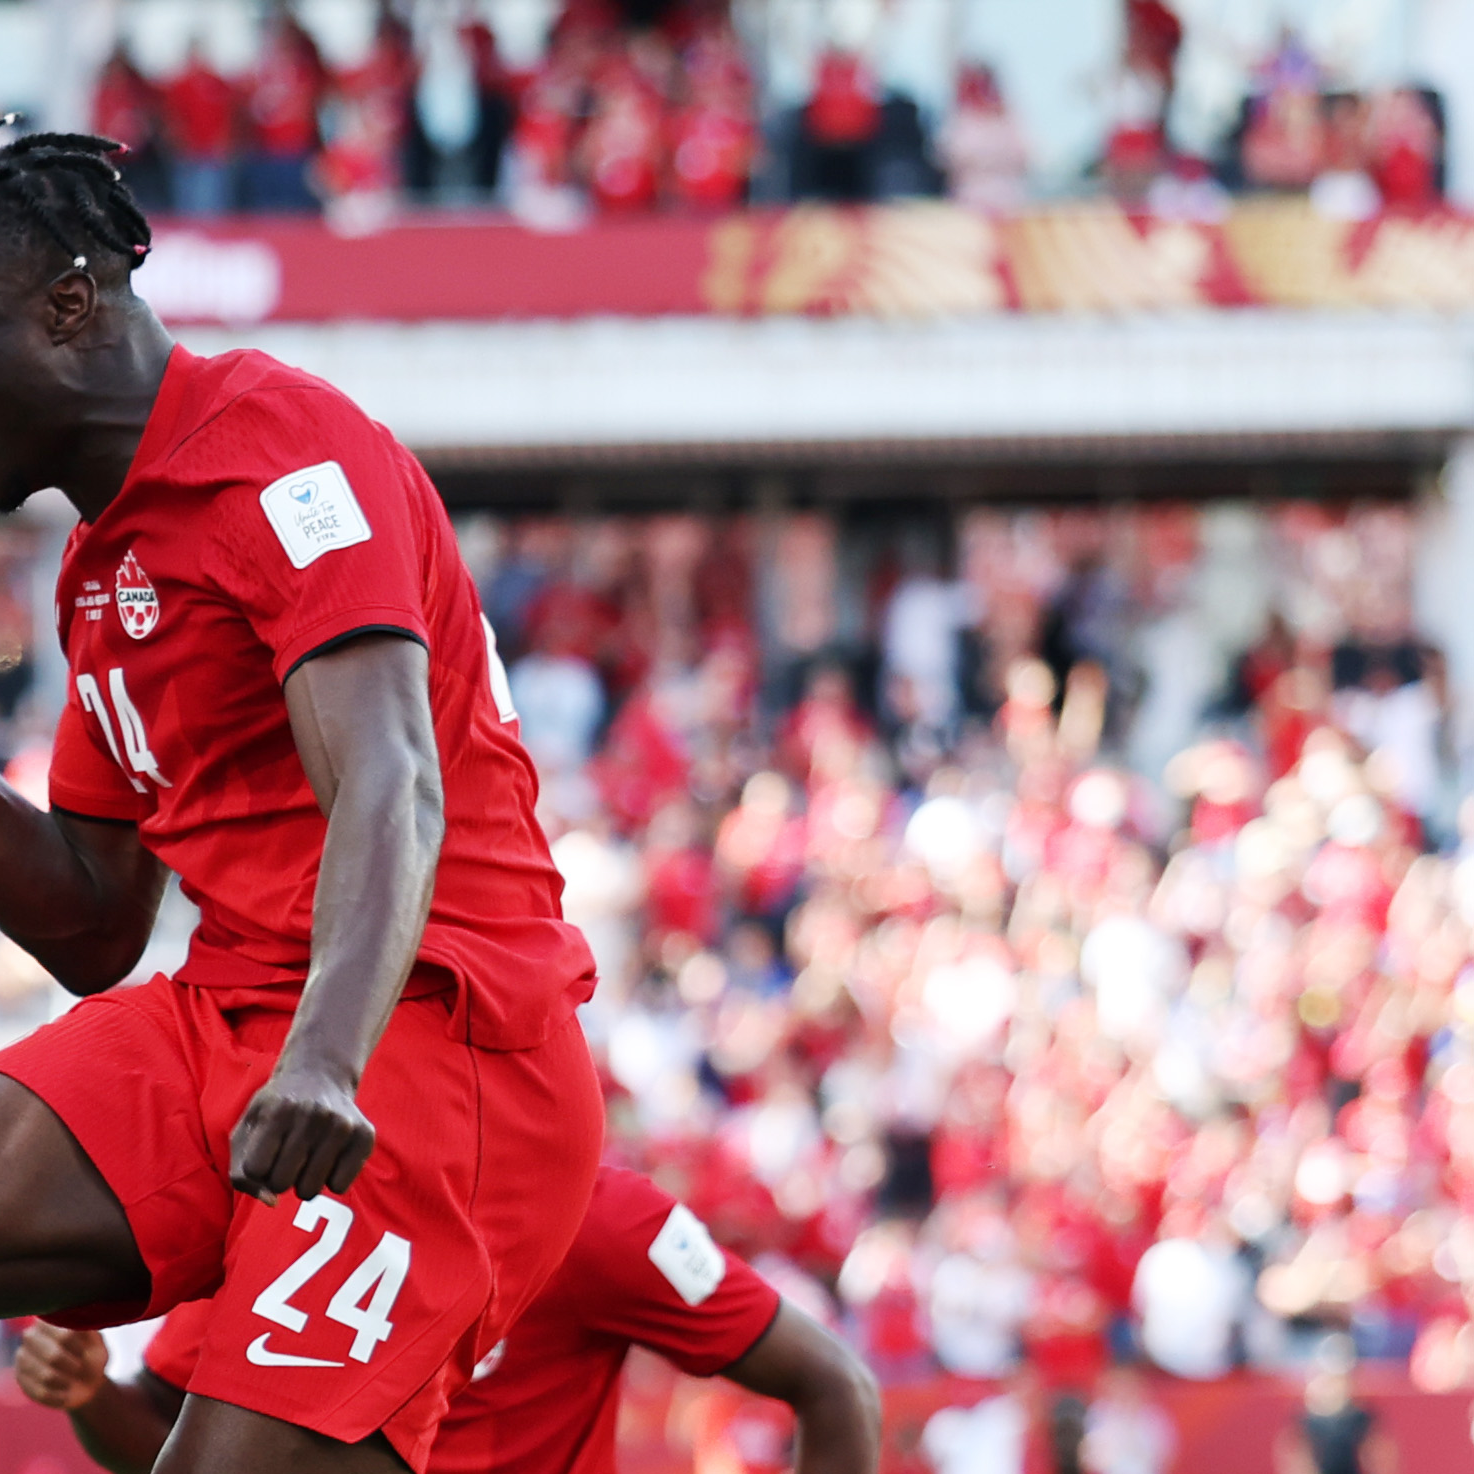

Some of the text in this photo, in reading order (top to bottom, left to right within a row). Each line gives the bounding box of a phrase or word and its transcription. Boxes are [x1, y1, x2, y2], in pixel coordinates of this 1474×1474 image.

[303, 514, 341, 539] PEACE
[118, 590, 155, 602] CANADA
[76, 667, 173, 794] 24
[251, 1194, 412, 1363] 24
